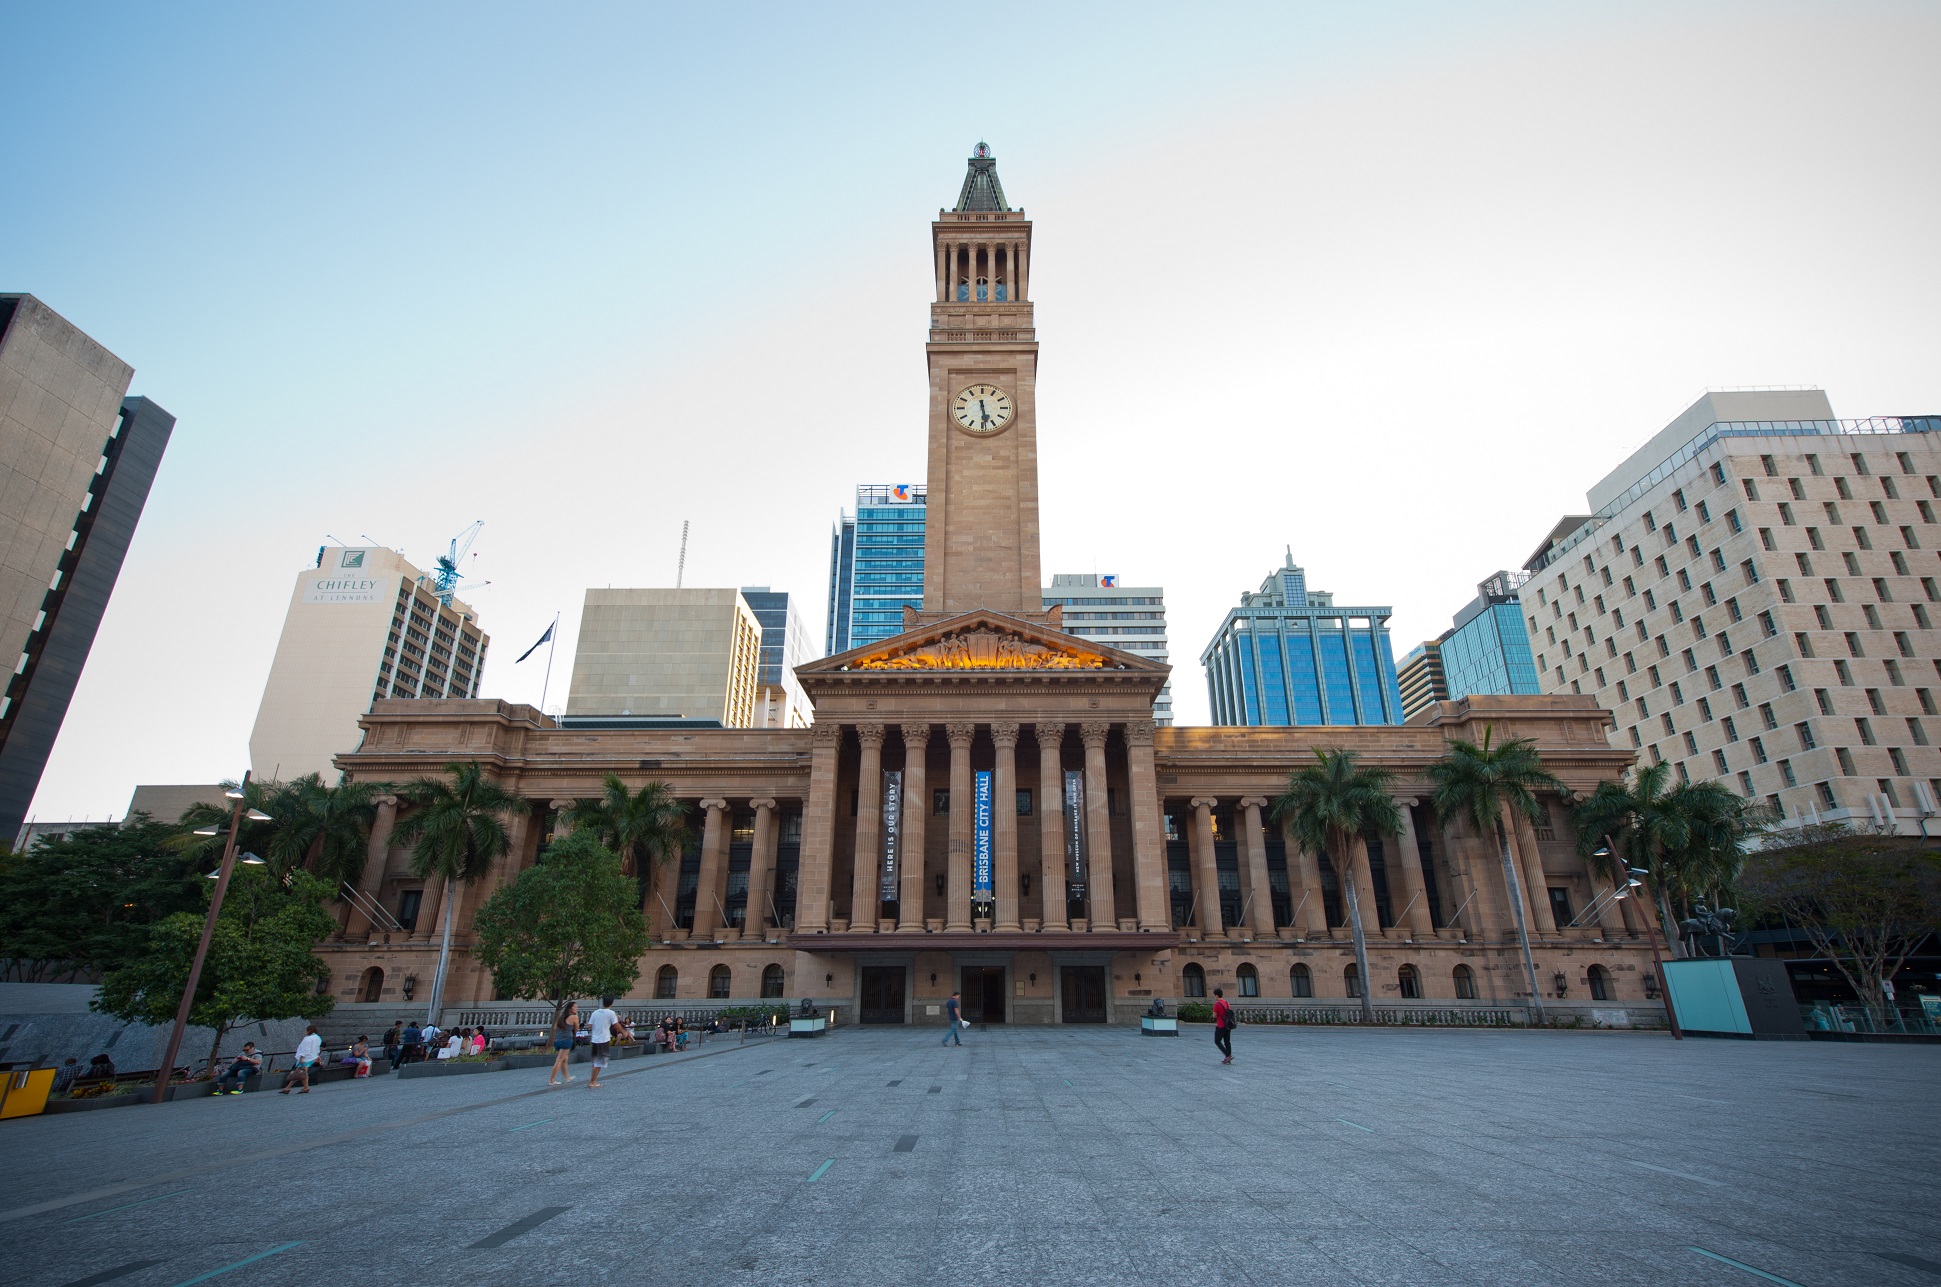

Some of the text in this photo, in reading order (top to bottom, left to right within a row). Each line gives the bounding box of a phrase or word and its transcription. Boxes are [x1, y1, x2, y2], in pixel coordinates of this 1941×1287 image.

[317, 581, 376, 590] CHIFLEY
[979, 775, 989, 883] BRISBANE CITY HALL
[888, 836, 894, 845] IS
